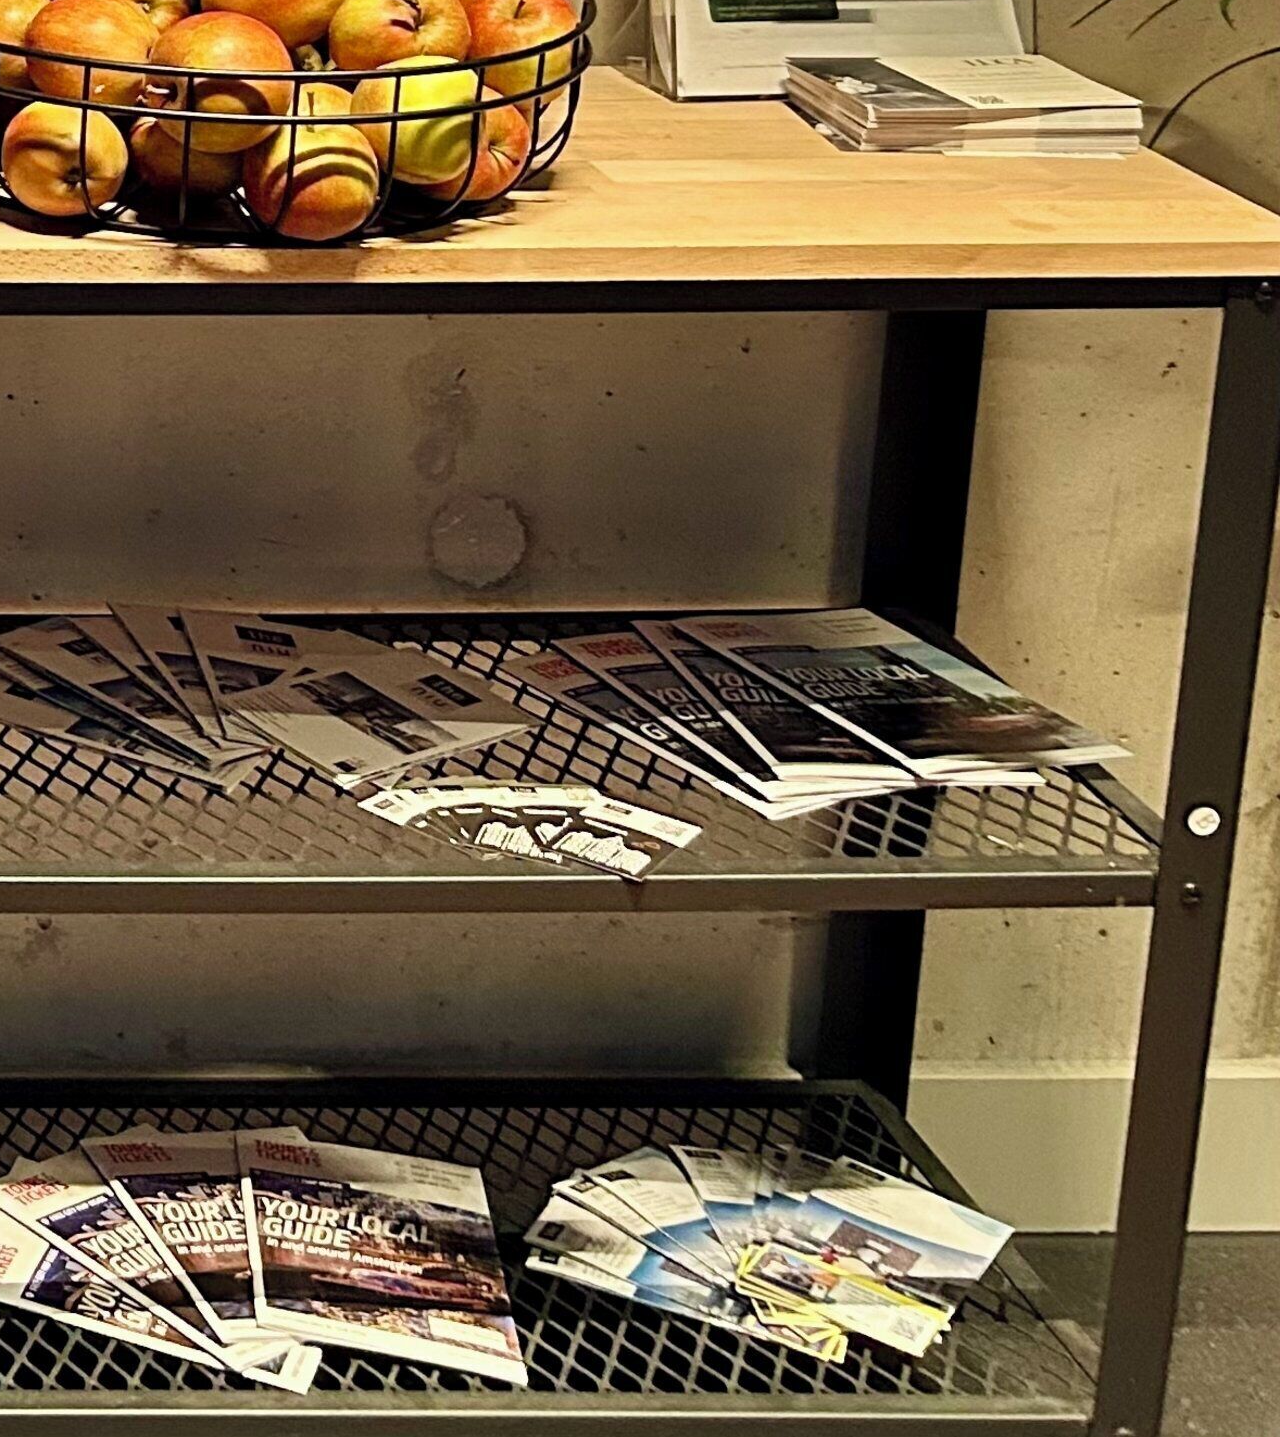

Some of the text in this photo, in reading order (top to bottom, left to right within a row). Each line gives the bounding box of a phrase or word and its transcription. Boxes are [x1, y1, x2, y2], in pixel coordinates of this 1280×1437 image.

[247, 629, 284, 643] the
[779, 664, 930, 684] YOUR LOCAL
[431, 679, 467, 703] the
[802, 681, 888, 700] GUIDE
[14, 1180, 70, 1206] TICKETS
[144, 1201, 220, 1223] YOUR
[260, 1196, 435, 1245] YOUR LOCAL
[79, 1221, 147, 1259] YOUR
[162, 1221, 246, 1245] GUIDE
[262, 1218, 351, 1249] GUIDE
